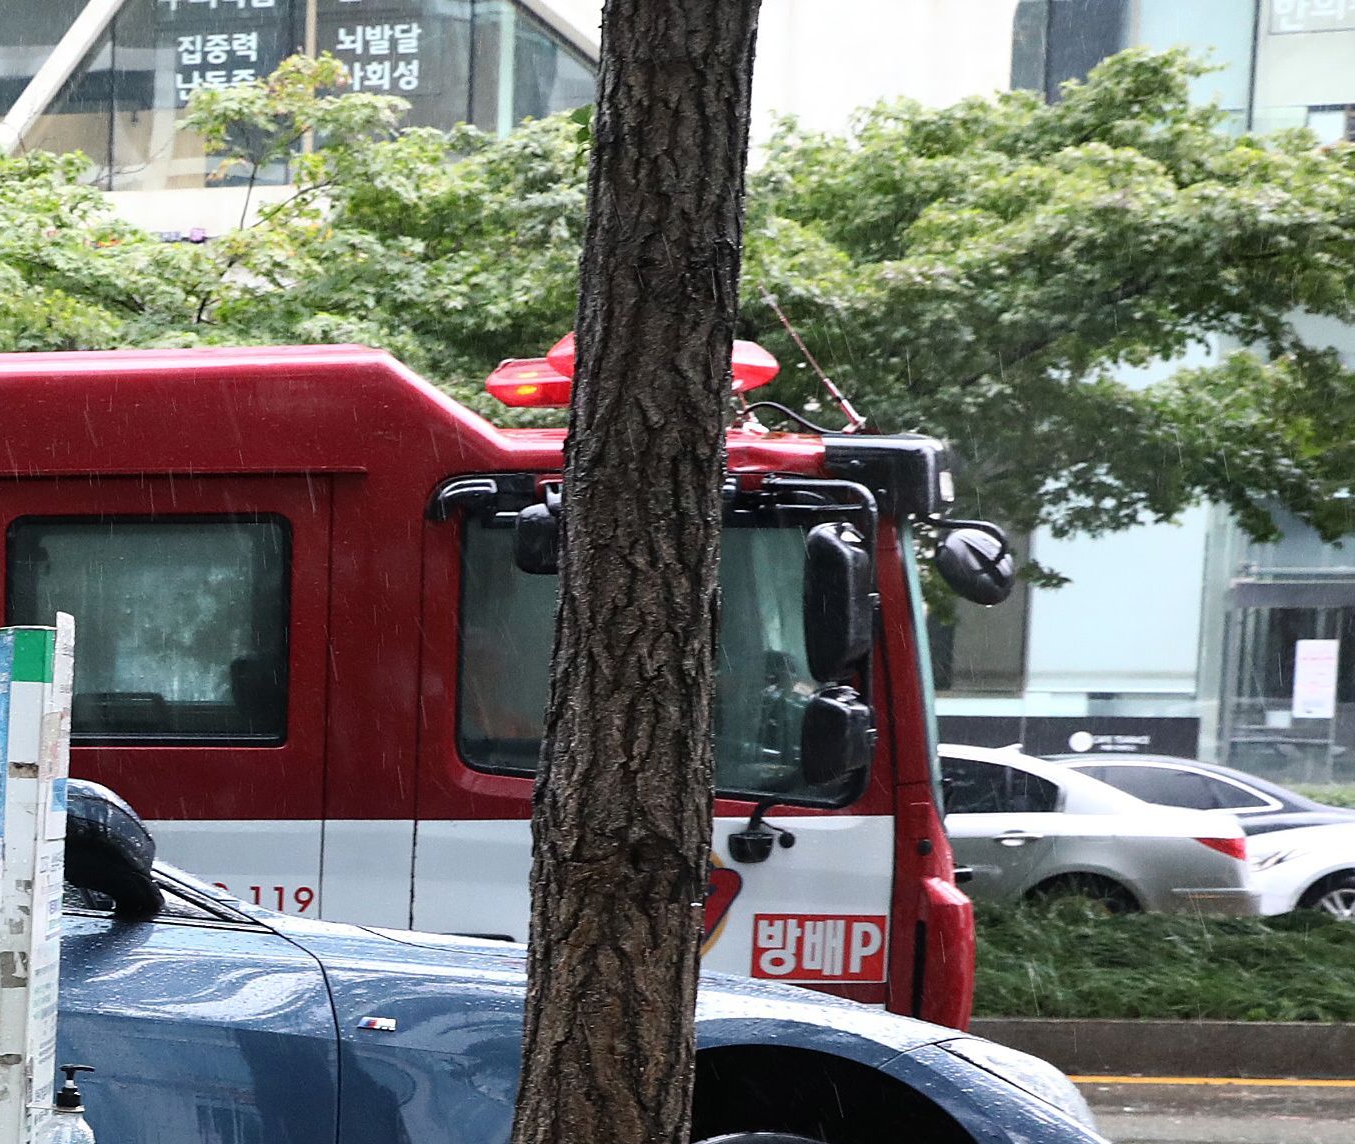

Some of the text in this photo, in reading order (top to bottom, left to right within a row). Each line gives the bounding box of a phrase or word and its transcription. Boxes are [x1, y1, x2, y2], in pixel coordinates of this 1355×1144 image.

[177, 32, 259, 65] 집중력
[336, 23, 422, 55] 뇌발달
[756, 918, 883, 976] 방배P
